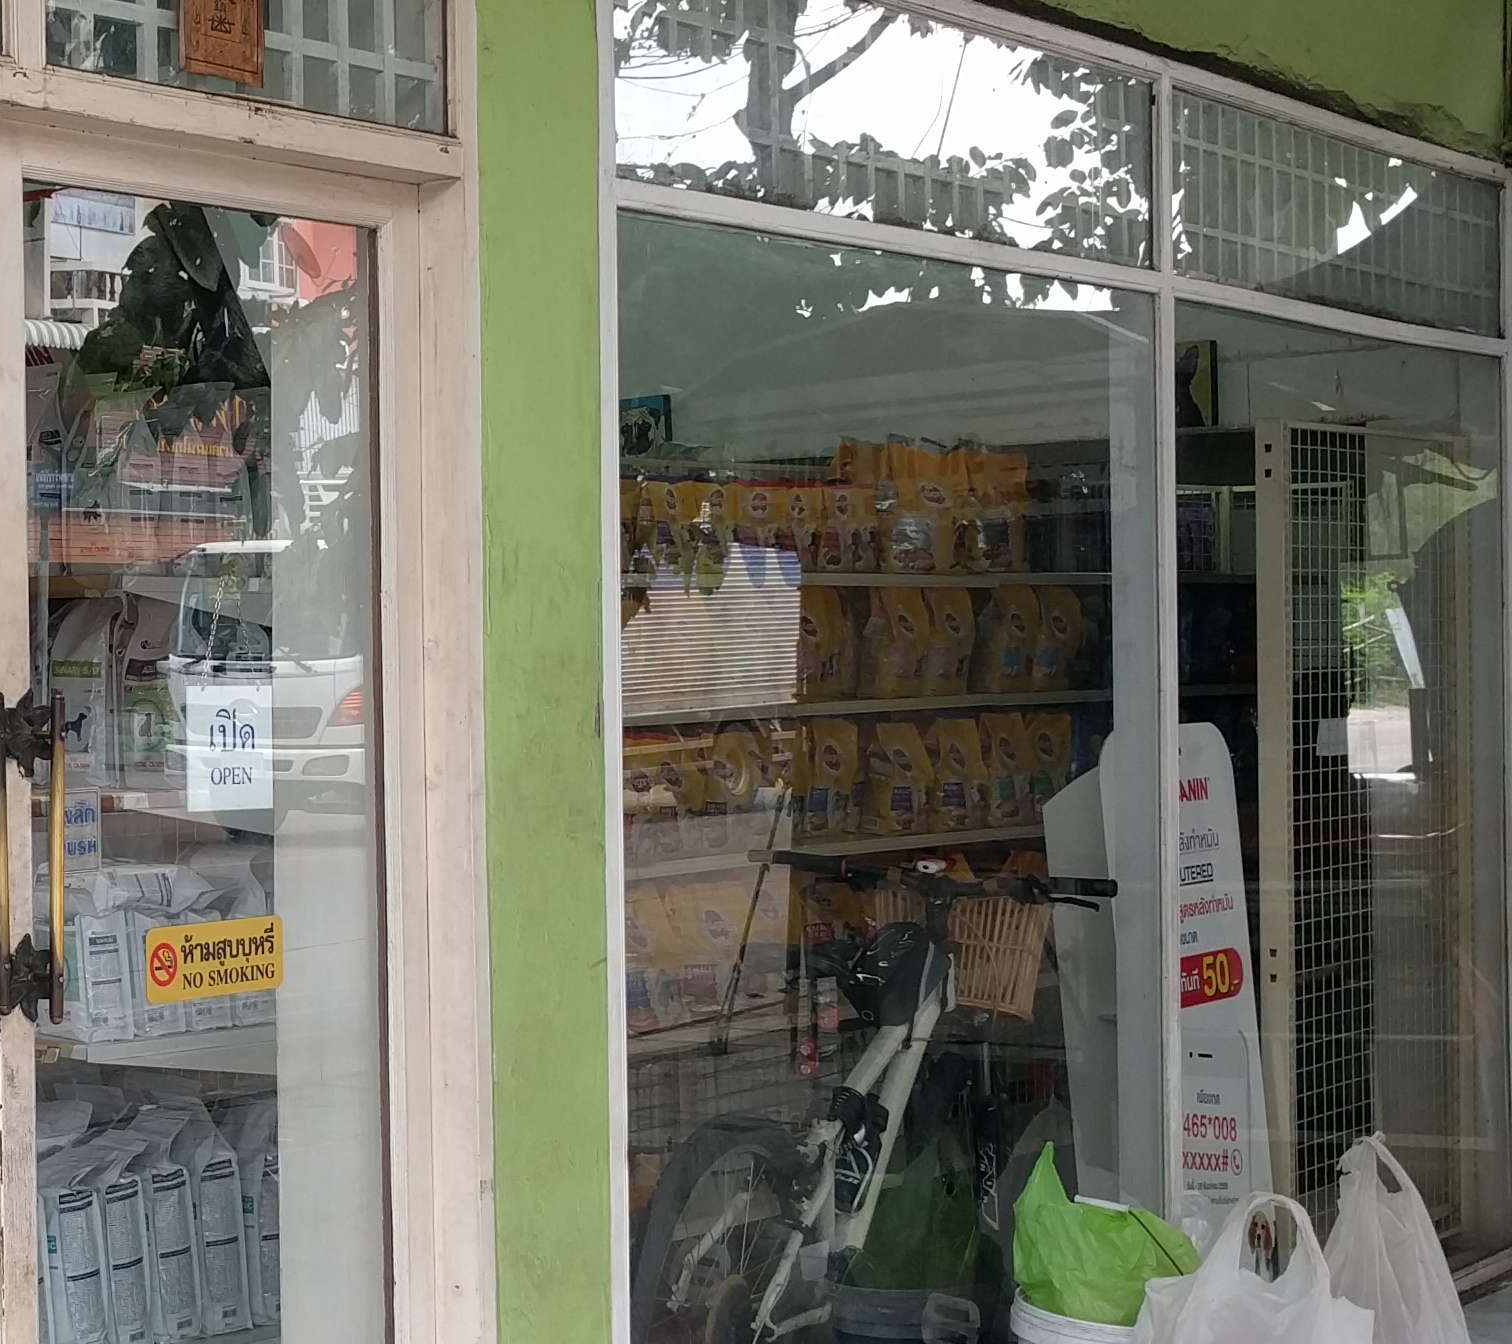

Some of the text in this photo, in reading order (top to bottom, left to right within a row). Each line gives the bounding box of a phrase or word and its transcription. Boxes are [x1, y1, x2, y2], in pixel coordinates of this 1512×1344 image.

[209, 708, 255, 752] เปิด
[210, 767, 253, 785] OPEN
[1178, 776, 1209, 803] ANIN
[65, 840, 97, 856] USH
[180, 922, 275, 966] ห้ามสูบบุหรี่
[182, 962, 275, 990] NO SMOKING
